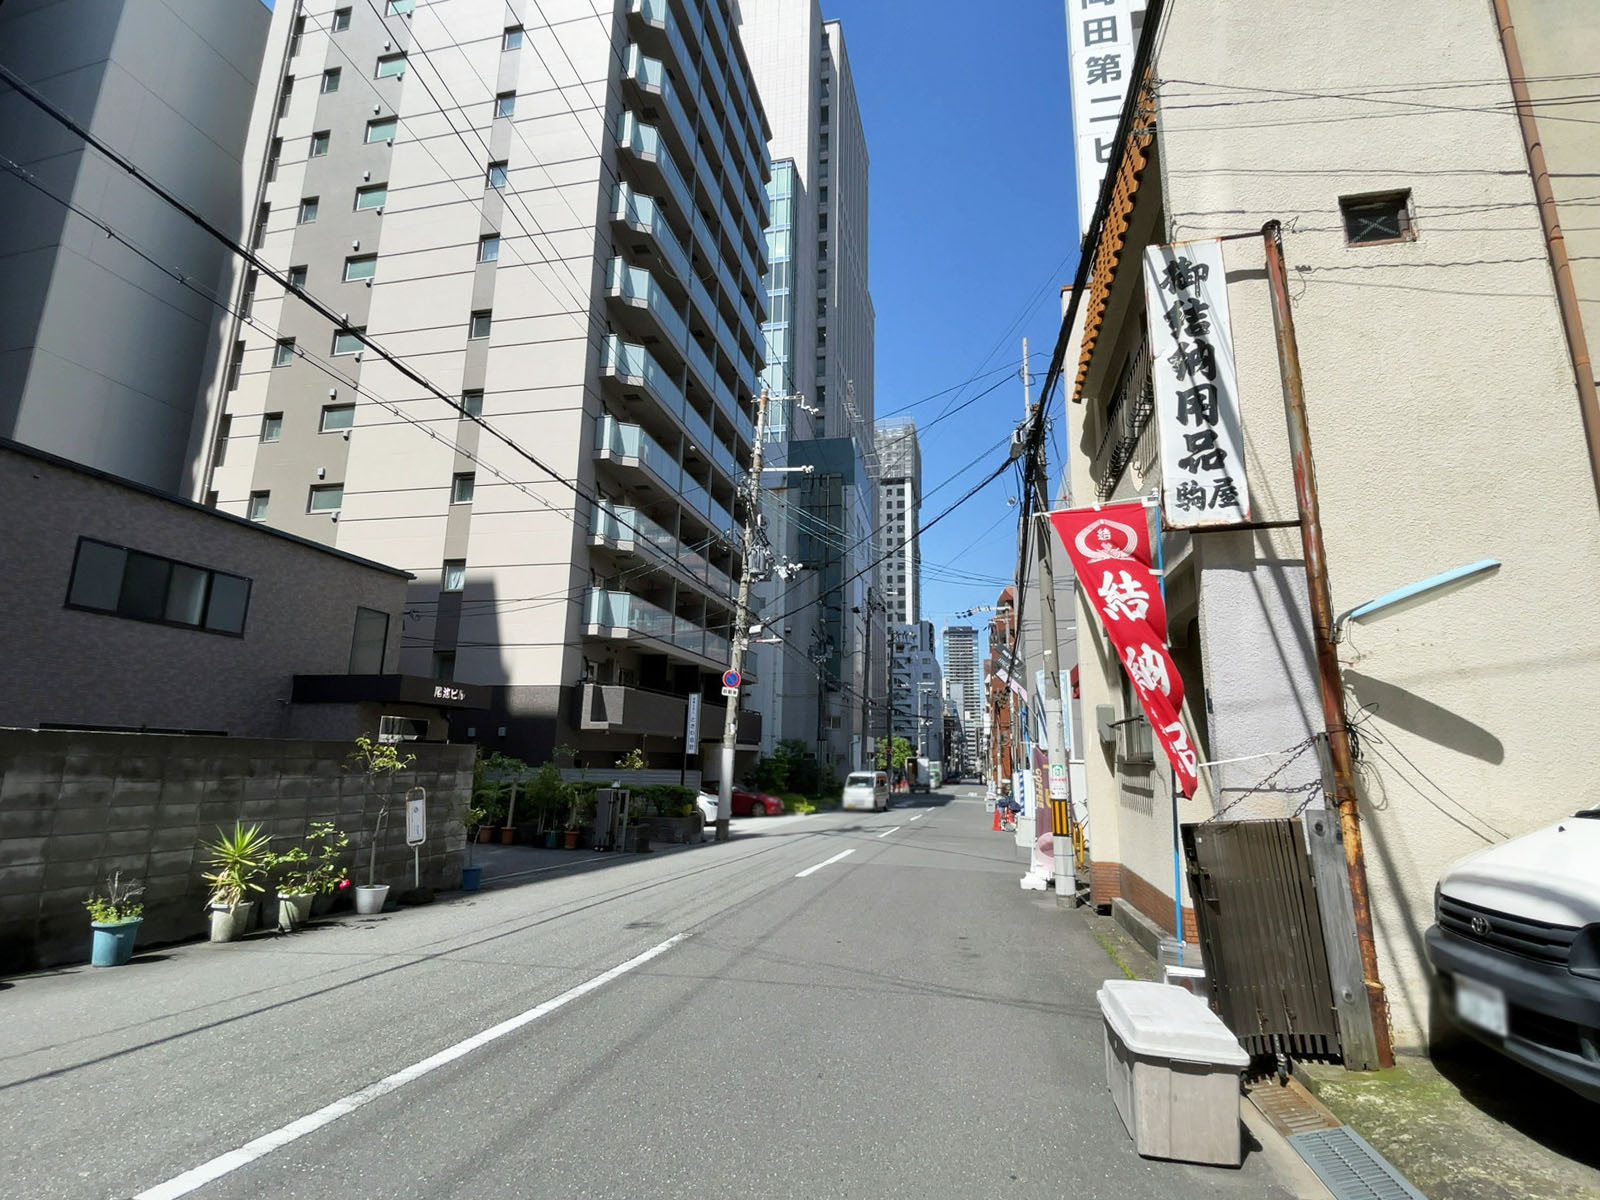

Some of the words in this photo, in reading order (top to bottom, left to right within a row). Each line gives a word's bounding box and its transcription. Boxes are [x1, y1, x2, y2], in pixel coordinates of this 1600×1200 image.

[1081, 0, 1122, 190] 田第二
[1159, 255, 1228, 474] 御結納用品
[1175, 477, 1241, 513] 駒屋
[1035, 768, 1045, 809] COFFEE
